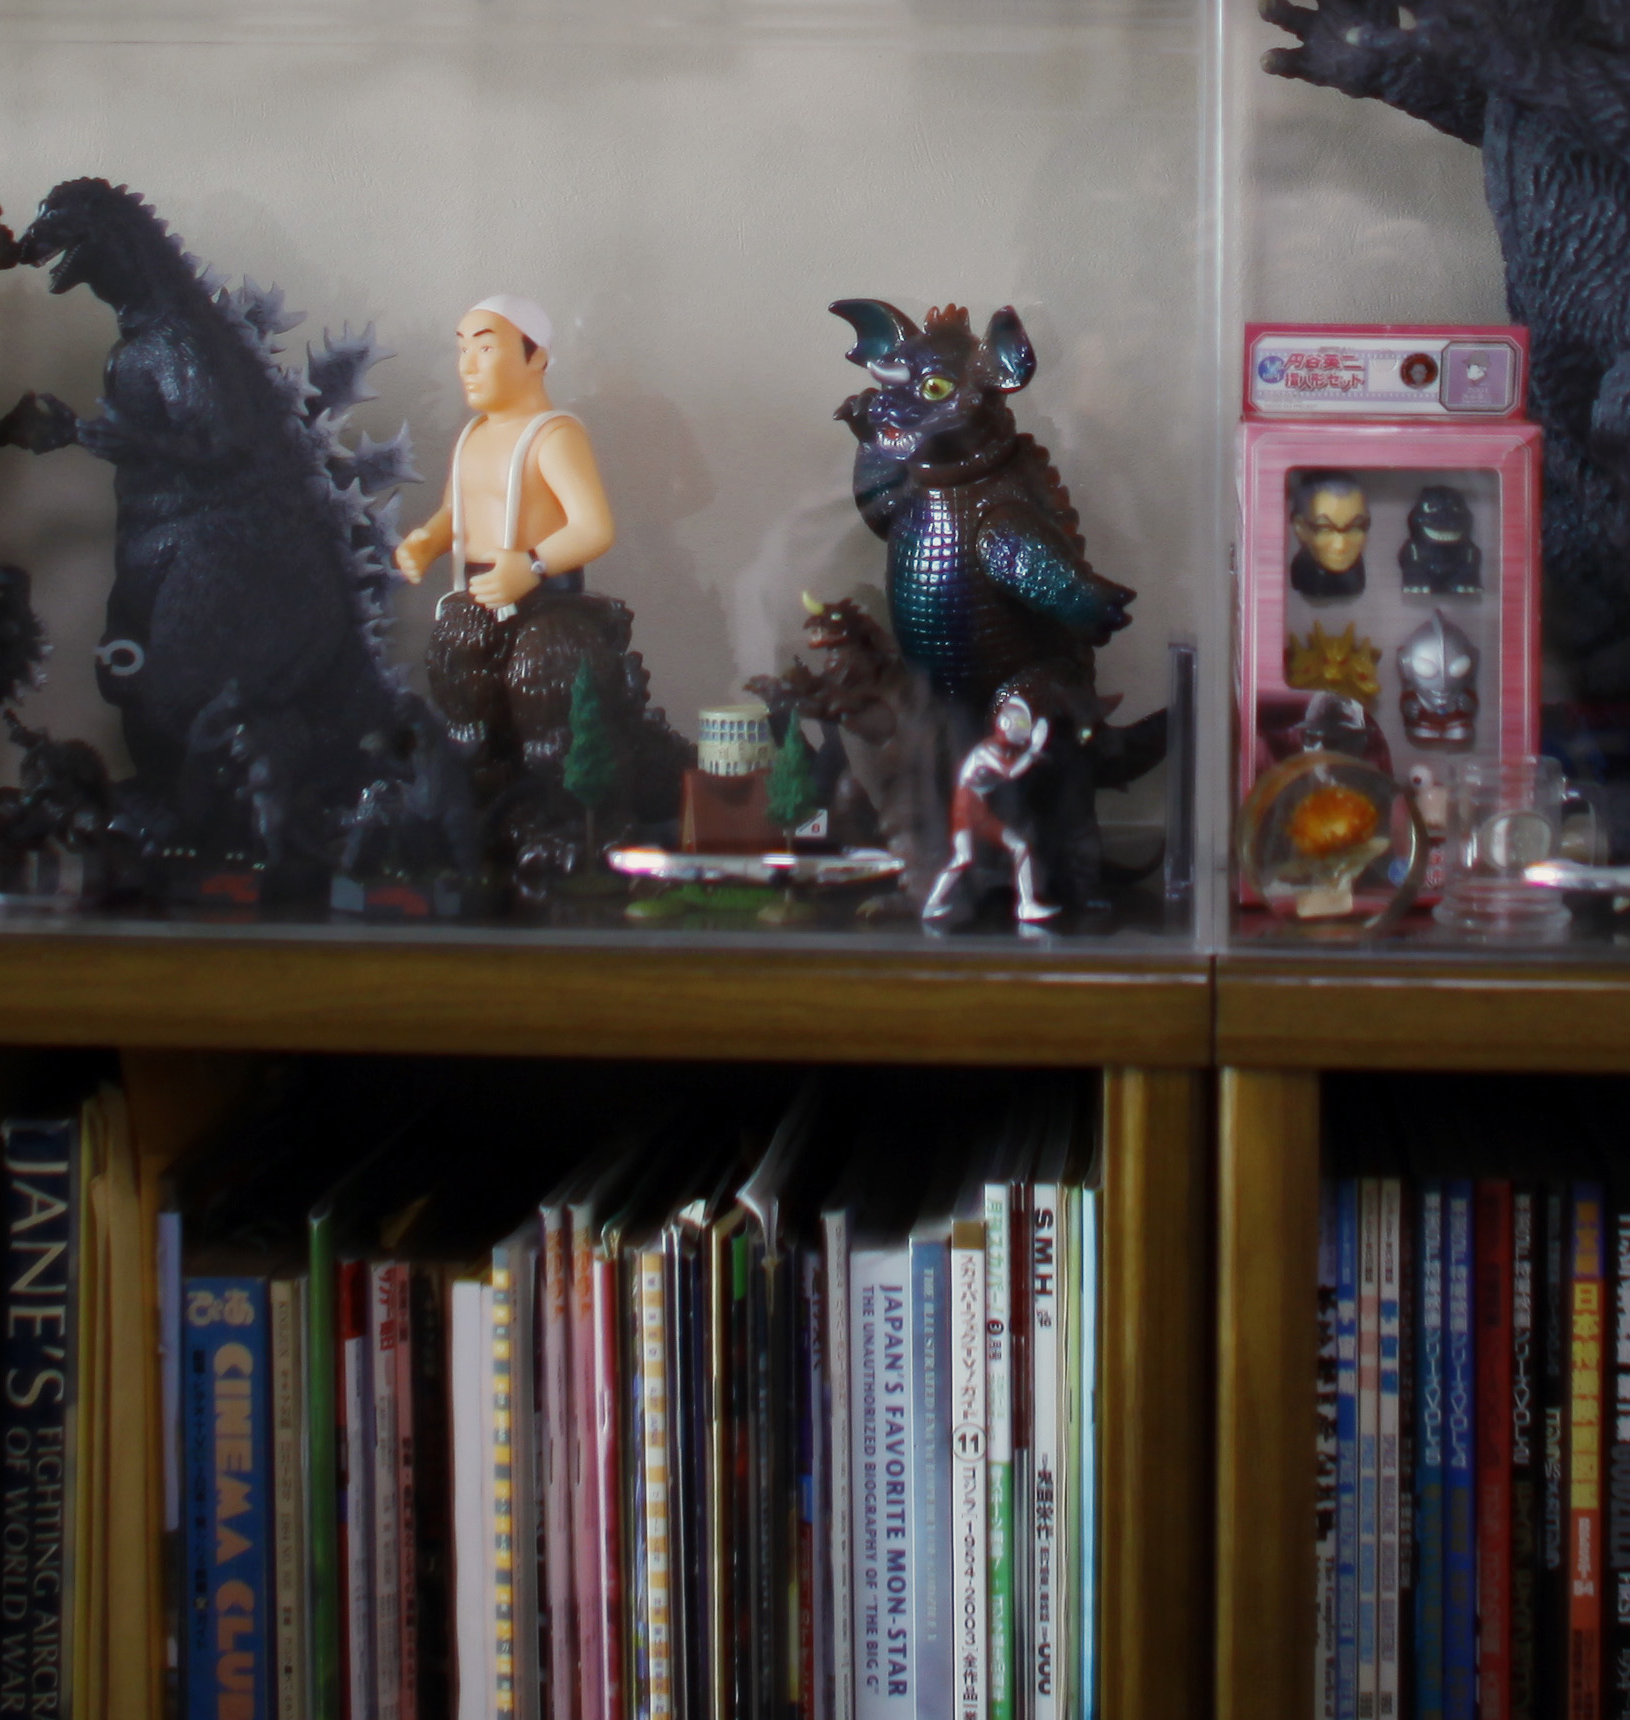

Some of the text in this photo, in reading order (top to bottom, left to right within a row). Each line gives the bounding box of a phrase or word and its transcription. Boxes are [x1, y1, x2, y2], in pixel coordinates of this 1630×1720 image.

[1283, 352, 1366, 372] 円谷英二
[4, 1158, 69, 1408] JANE'S
[862, 1284, 875, 1317] THE
[922, 1267, 935, 1298] THE
[863, 1322, 876, 1456] UNAUTHORIZED
[923, 1301, 936, 1408] ILLUSTRATED
[212, 1344, 254, 1566] CINEMA
[879, 1284, 908, 1697] JAPAN'S FAVORITE MON-STAR
[32, 1426, 64, 1597] FIGHTING
[864, 1463, 878, 1561] BIOGRAPHY
[0, 1426, 31, 1711] OF WORLD WAR
[865, 1569, 879, 1590] OF
[867, 1640, 879, 1670] BIG
